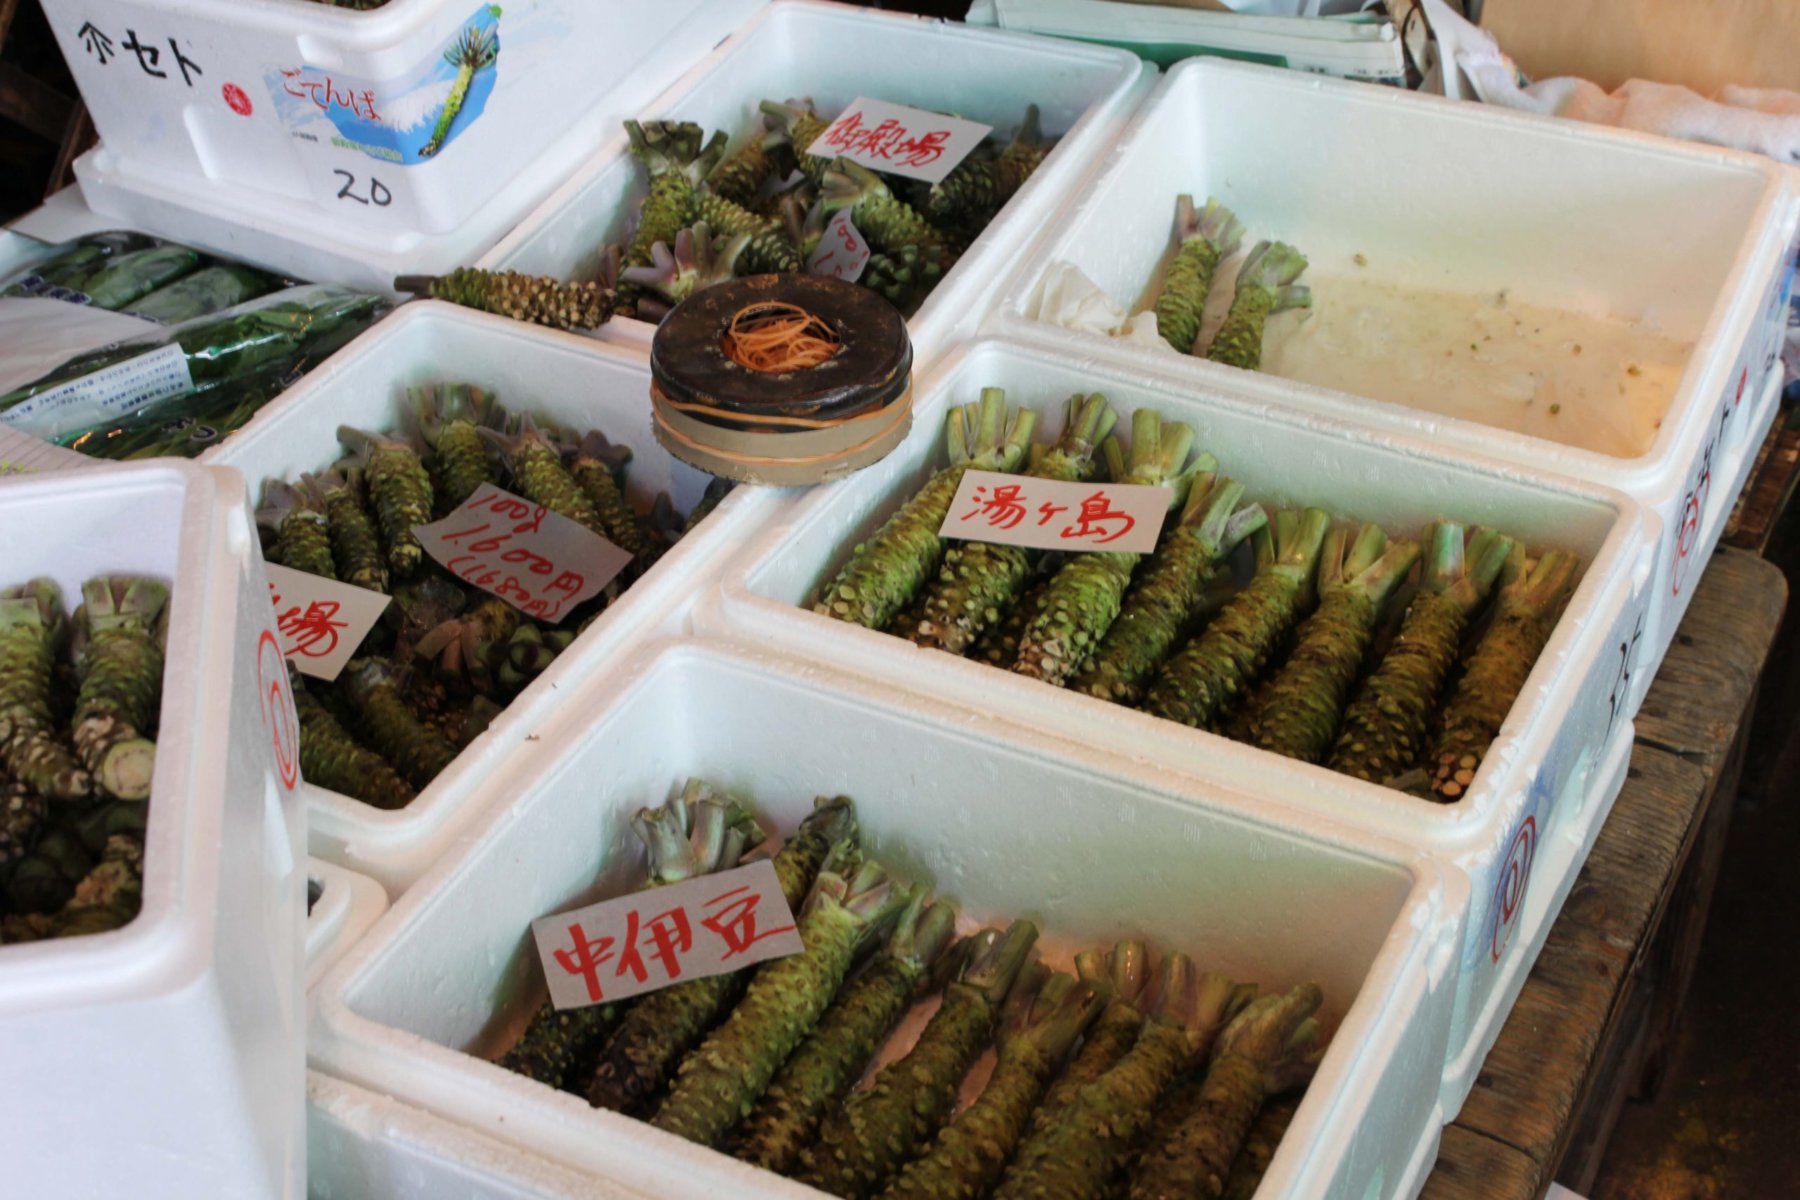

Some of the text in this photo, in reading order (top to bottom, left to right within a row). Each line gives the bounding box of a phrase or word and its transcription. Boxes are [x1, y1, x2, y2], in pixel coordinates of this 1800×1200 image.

[281, 69, 382, 120] ごてんば
[825, 111, 951, 167] 御殿場
[333, 168, 392, 206] 20
[553, 885, 797, 1002] 中伊豆
